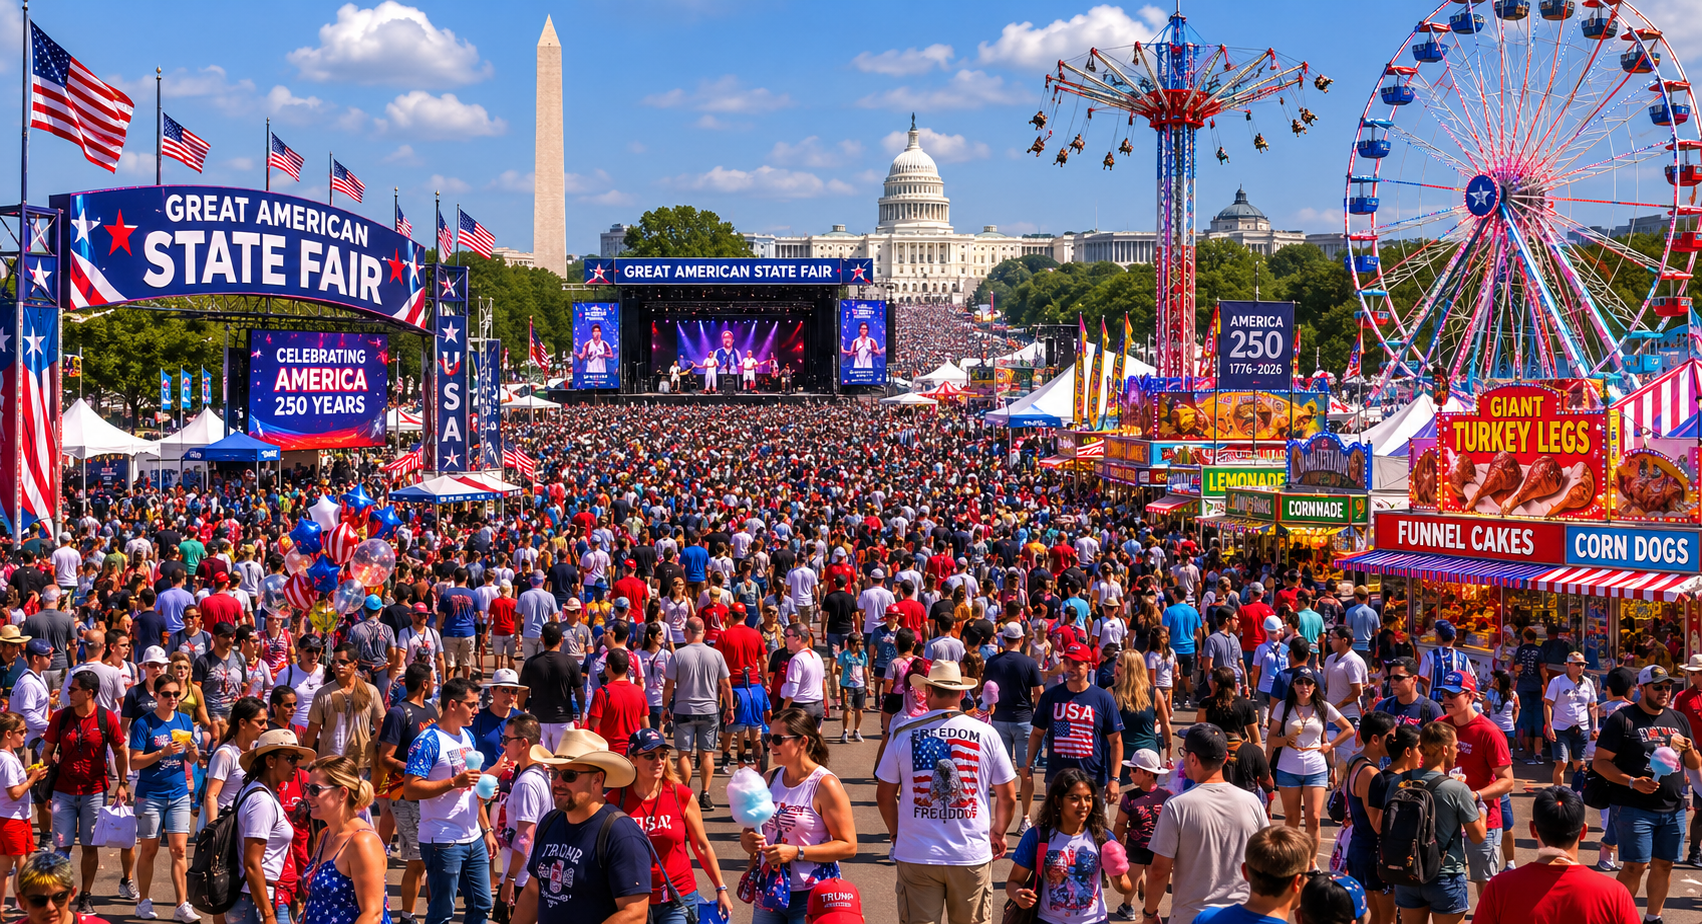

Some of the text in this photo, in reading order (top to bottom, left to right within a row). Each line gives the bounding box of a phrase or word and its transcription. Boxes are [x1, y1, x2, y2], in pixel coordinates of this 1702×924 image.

[165, 194, 369, 248] GREAT AMERICAN
[142, 230, 383, 306] STATE FAIR
[624, 264, 833, 279] GREAT AMERICAN STATE FAIR
[1230, 315, 1284, 328] AMERICA
[276, 347, 366, 364] CELEBRATING
[1229, 329, 1283, 359] 250
[274, 367, 368, 392] AMERICA
[1228, 363, 1283, 376] 1776-2026
[274, 395, 365, 416] 250 YEARS
[441, 351, 462, 442] USA
[1490, 395, 1544, 418] GIANT
[1452, 420, 1532, 453] TURKEY
[1537, 420, 1592, 455] LEGS
[1208, 472, 1286, 492] LEMONADE
[1398, 520, 1534, 555] FUNNEL CAKES
[1575, 533, 1690, 565] CORN DOGS
[1053, 702, 1095, 722] USA
[911, 728, 980, 742] FREEDOM
